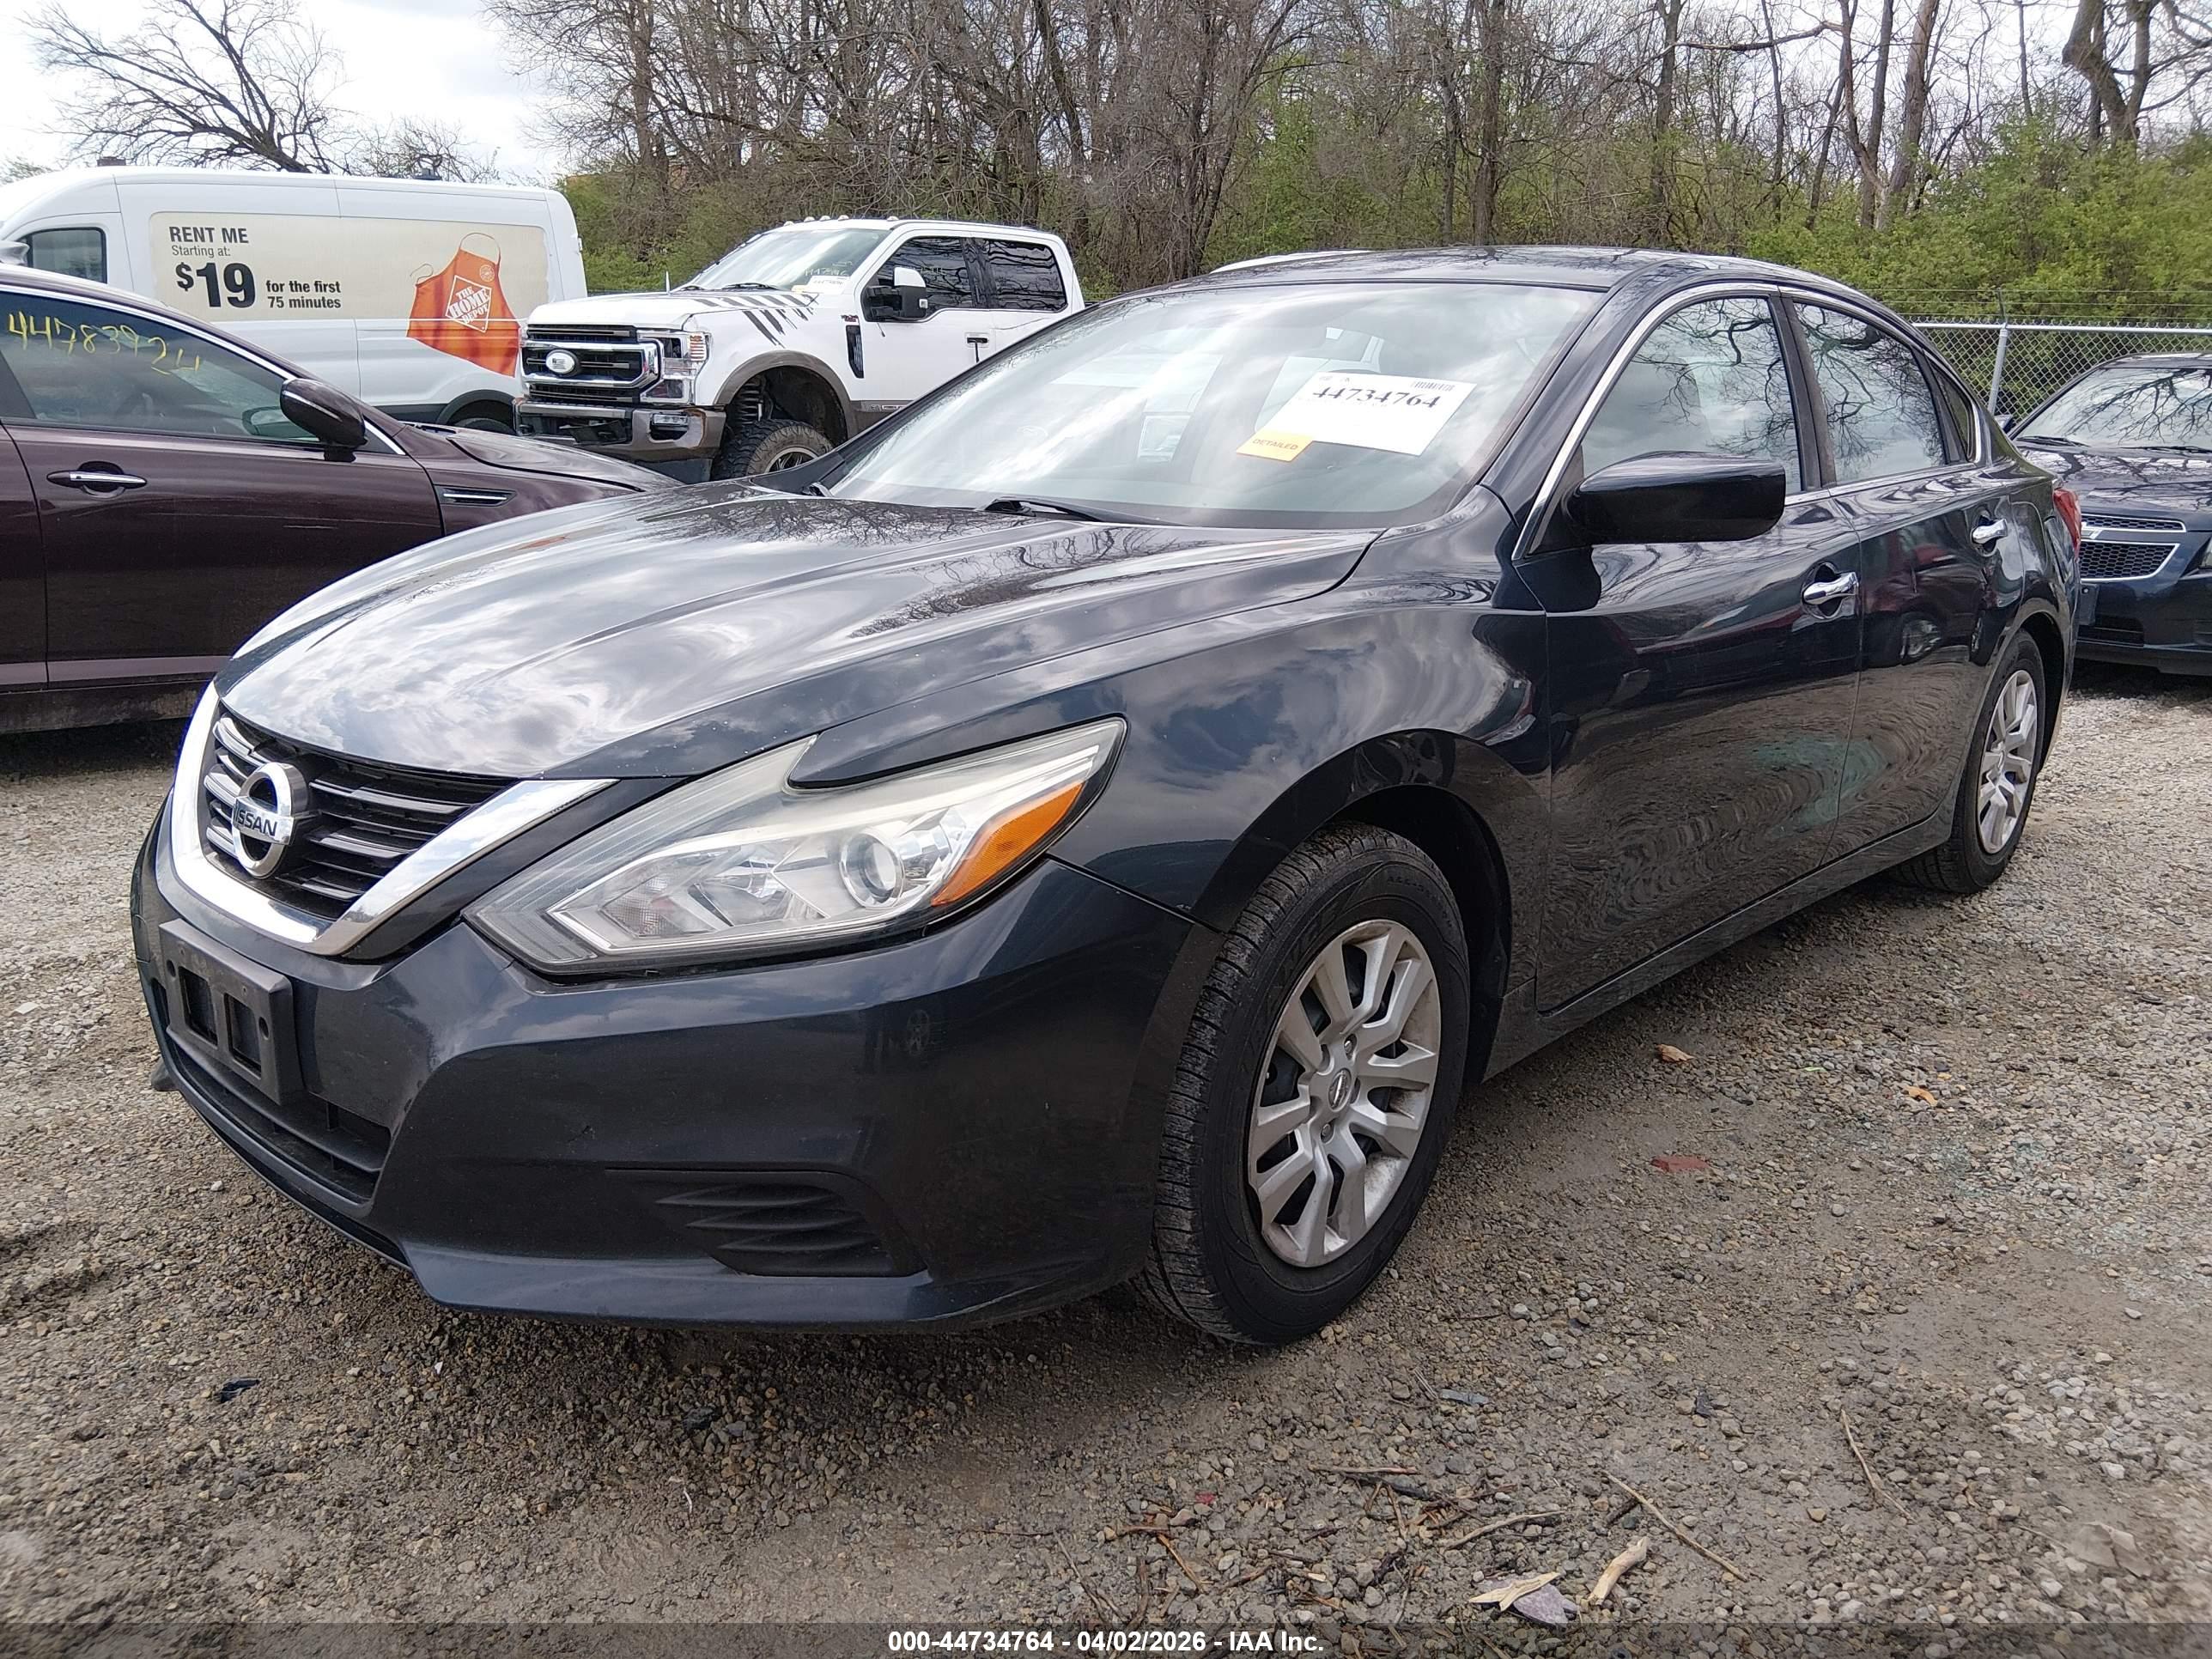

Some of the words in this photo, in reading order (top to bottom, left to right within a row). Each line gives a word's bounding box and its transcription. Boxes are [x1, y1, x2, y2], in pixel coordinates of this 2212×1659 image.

[169, 226, 215, 243] RENT
[222, 228, 249, 244] ME
[172, 246, 215, 258] Starting
[217, 246, 231, 257] at:
[175, 262, 256, 308] $19
[266, 280, 285, 293] for
[289, 281, 310, 293] the
[314, 281, 341, 293] first
[455, 286, 474, 300] THE
[267, 296, 284, 308] 75
[289, 296, 341, 308] minutes
[449, 288, 489, 319] HOME
[462, 303, 489, 325] DEPOT
[1313, 386, 1442, 409] 44734764
[1252, 438, 1299, 451] DETAILED
